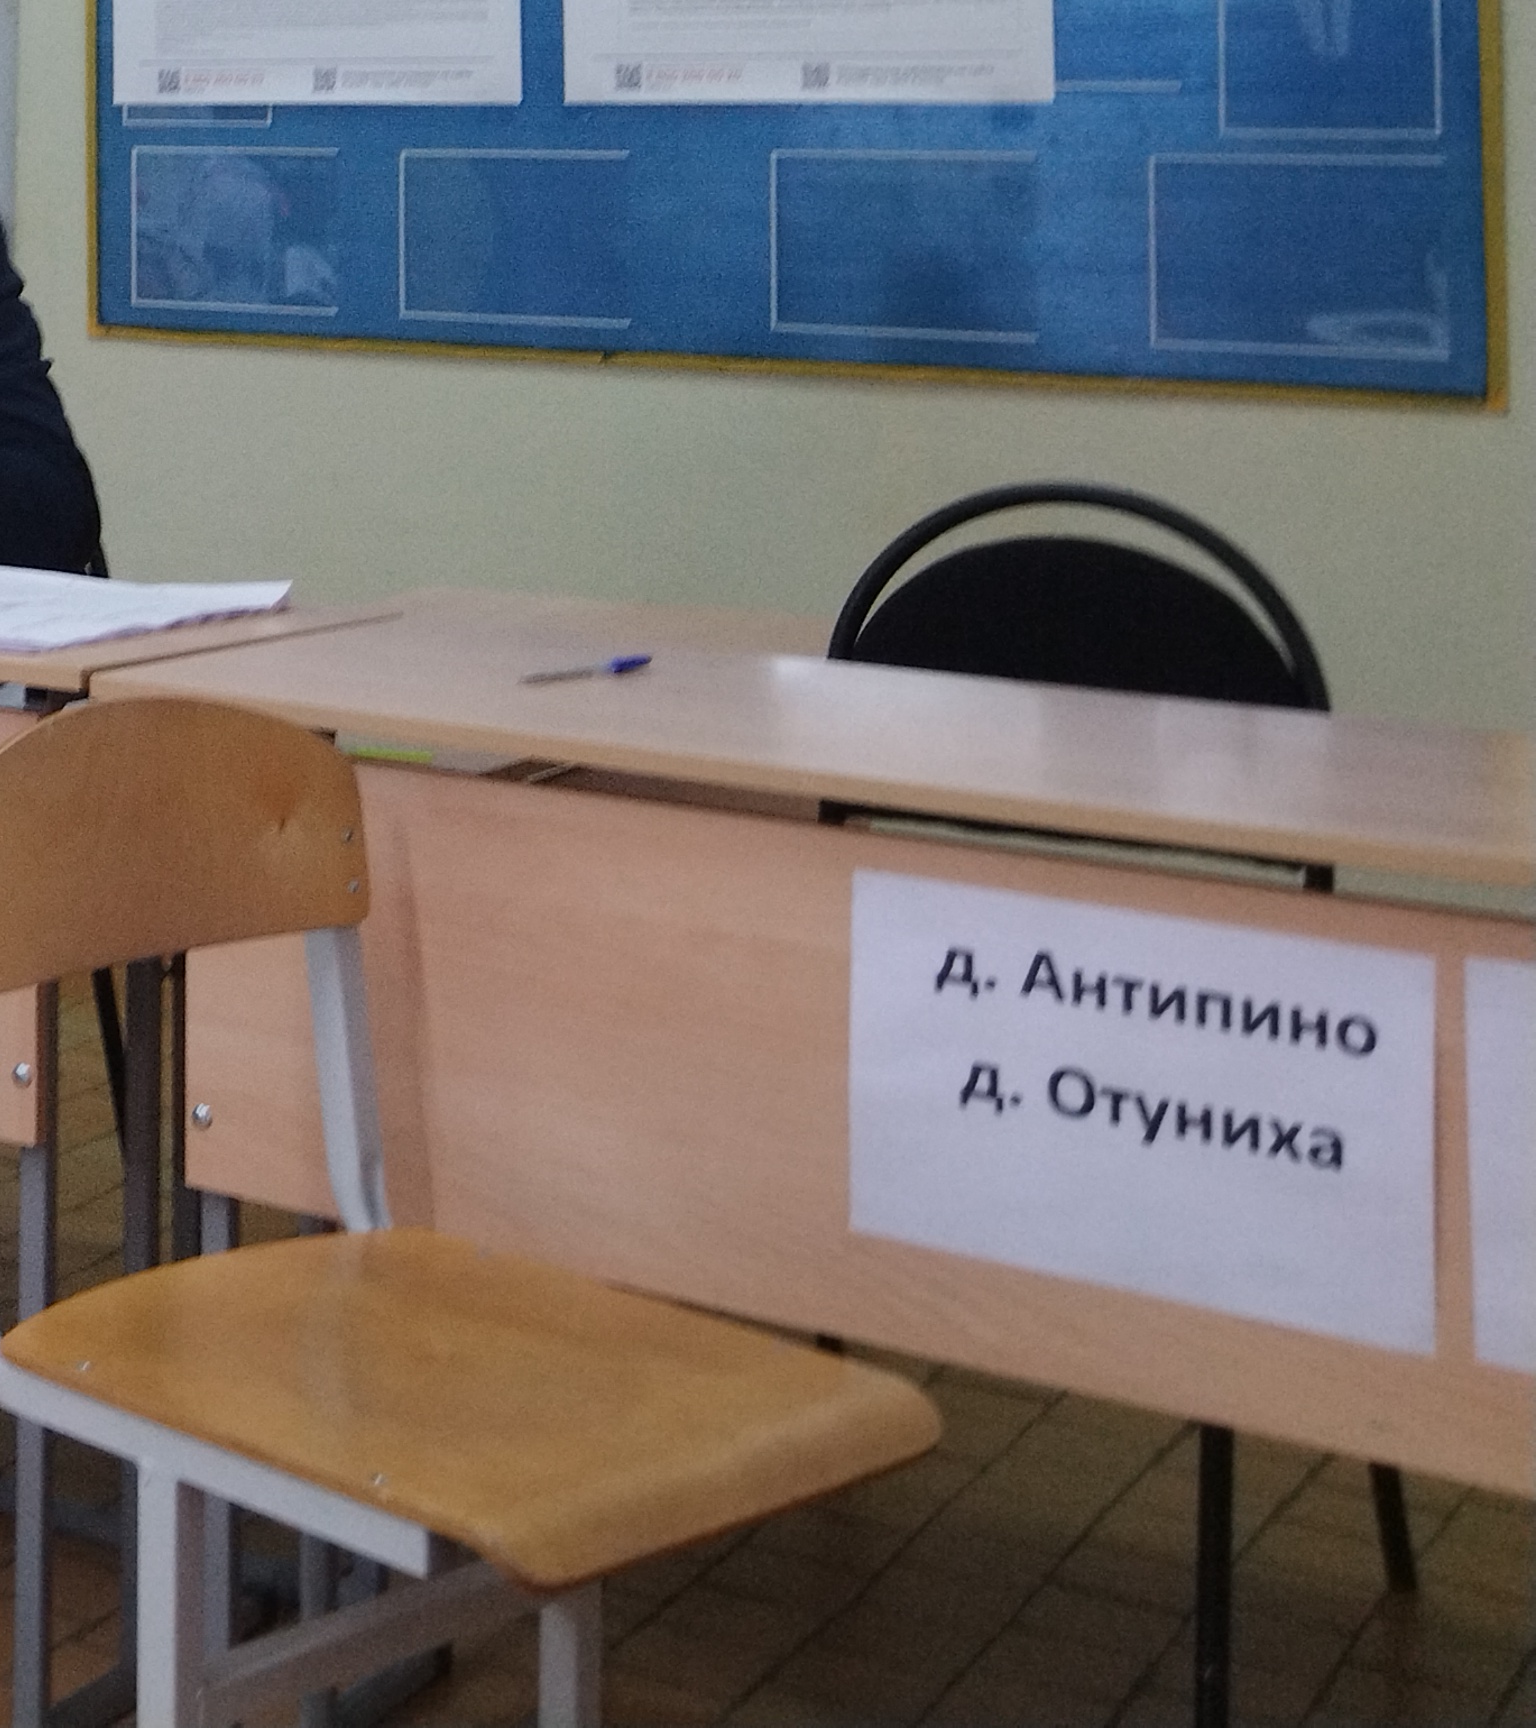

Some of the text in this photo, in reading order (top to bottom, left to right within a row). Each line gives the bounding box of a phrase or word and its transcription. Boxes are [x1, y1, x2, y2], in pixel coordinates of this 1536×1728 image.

[933, 946, 1379, 1059] д. Антипино
[959, 1060, 1347, 1173] д. Отуниха
